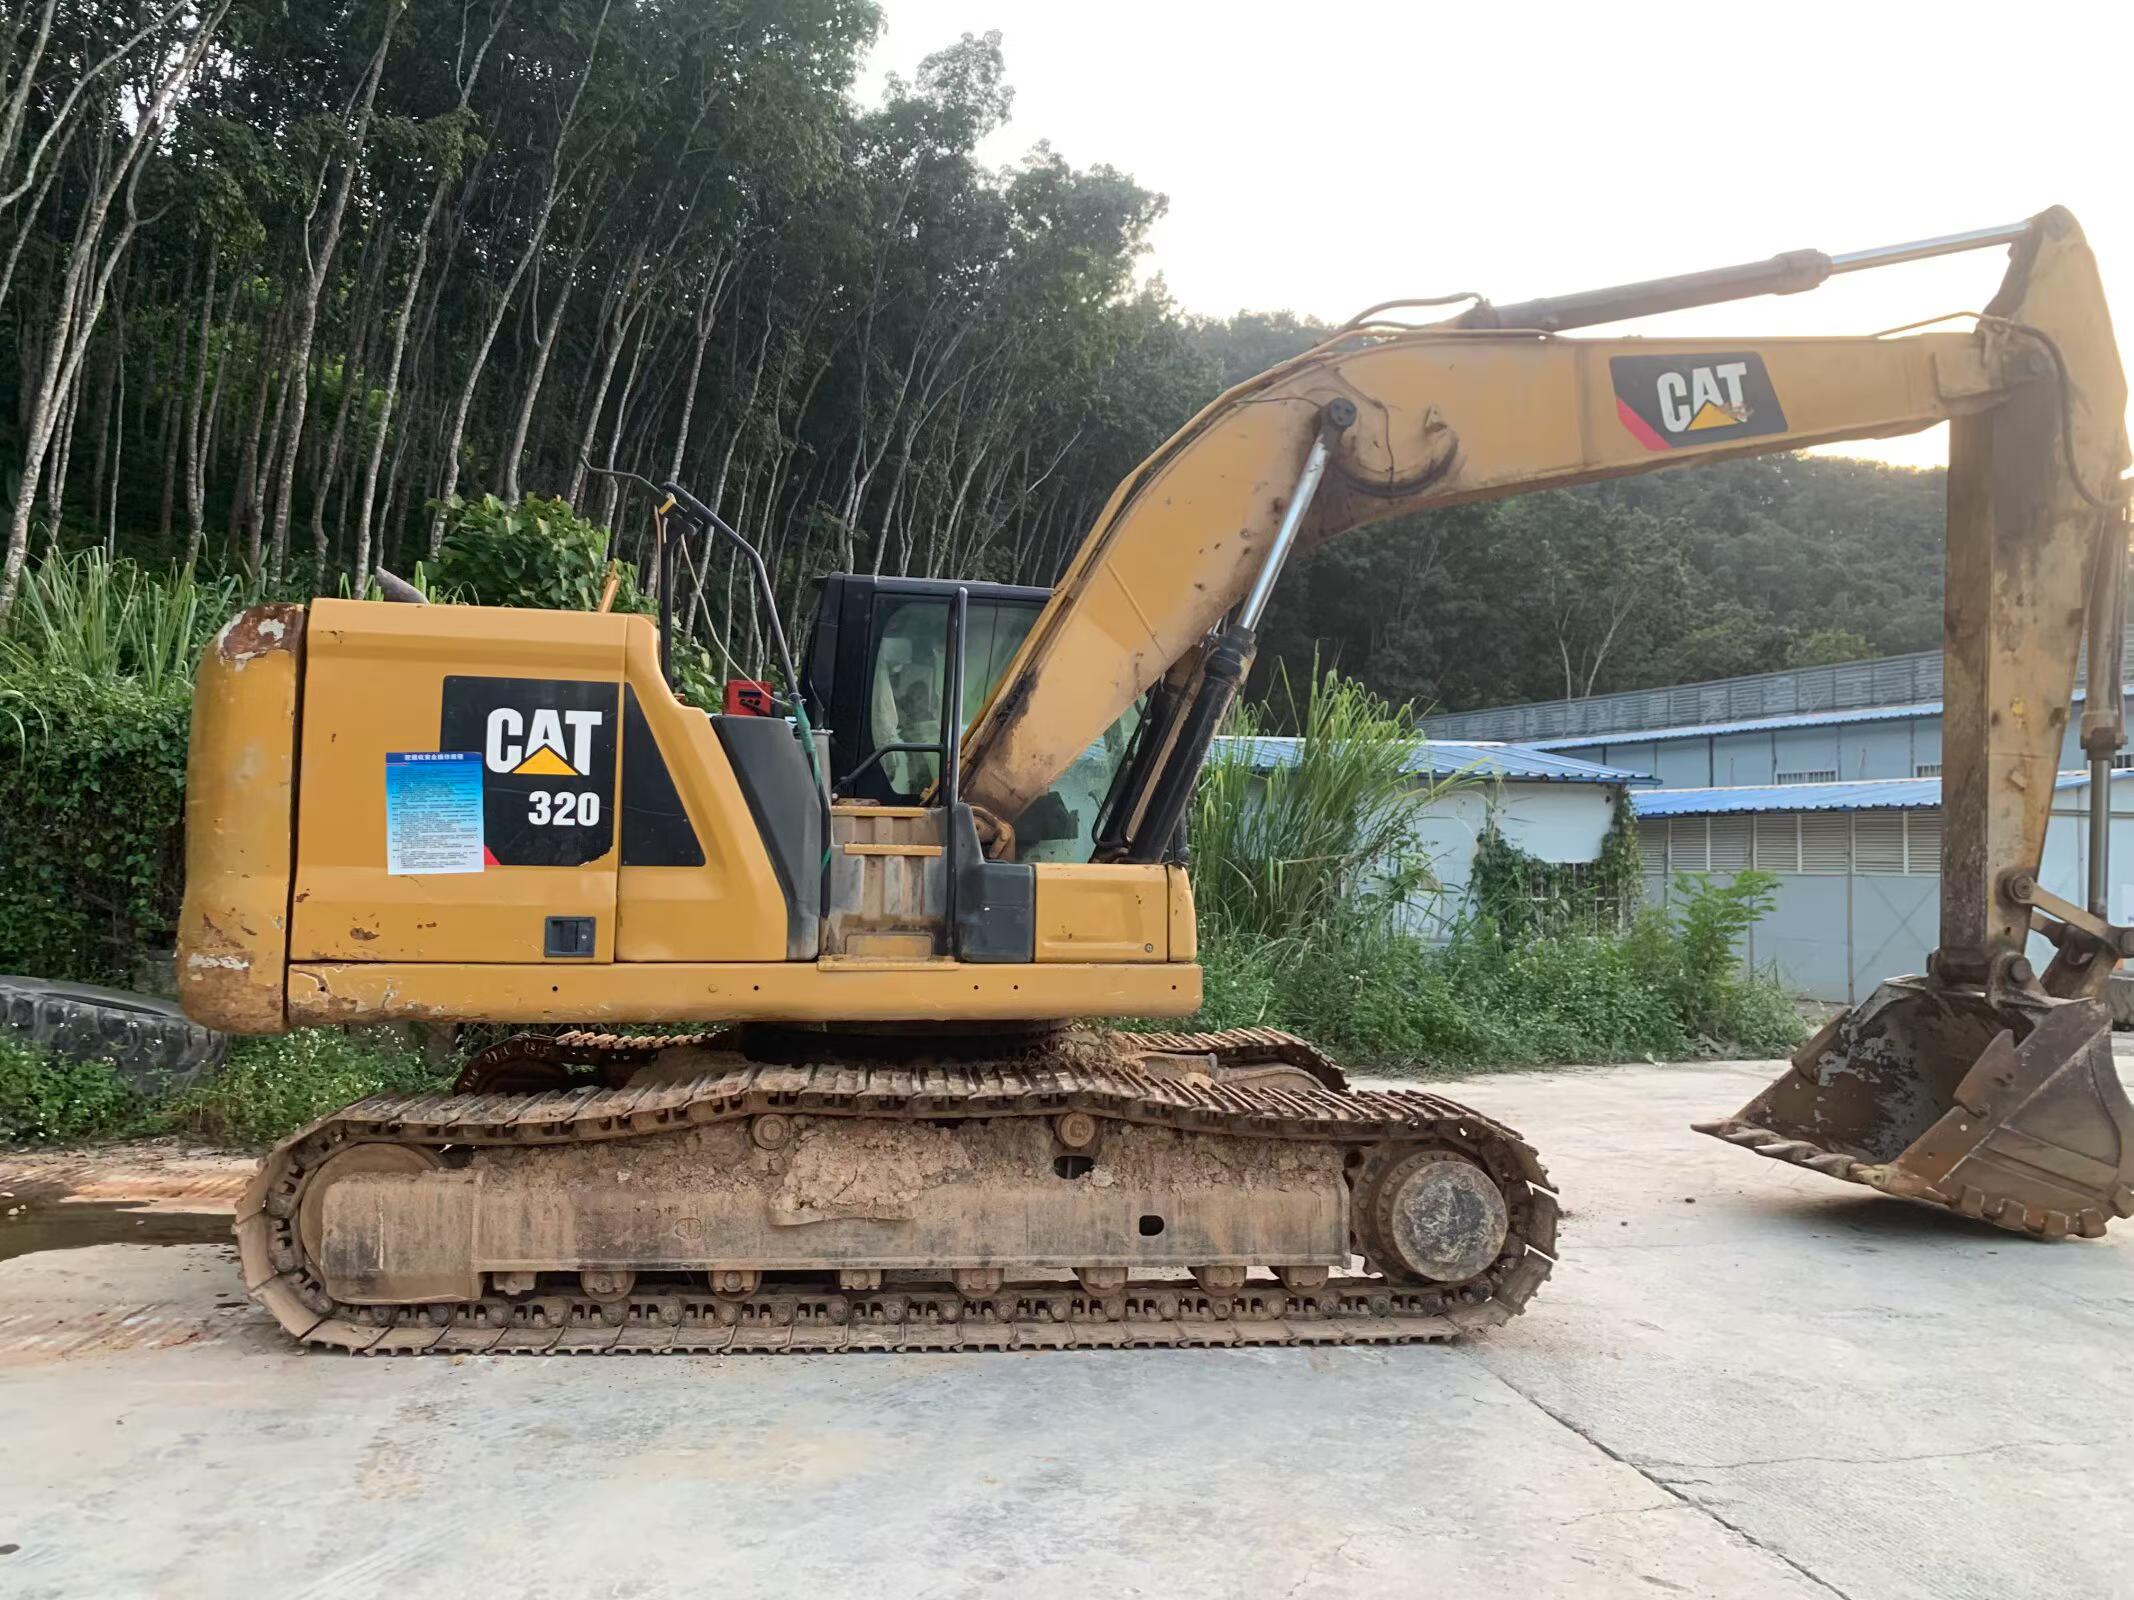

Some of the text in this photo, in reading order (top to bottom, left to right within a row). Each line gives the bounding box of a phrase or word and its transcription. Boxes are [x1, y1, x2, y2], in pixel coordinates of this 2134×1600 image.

[1656, 361, 1748, 433] CAT
[485, 707, 603, 776] CAT
[528, 790, 600, 827] 320
